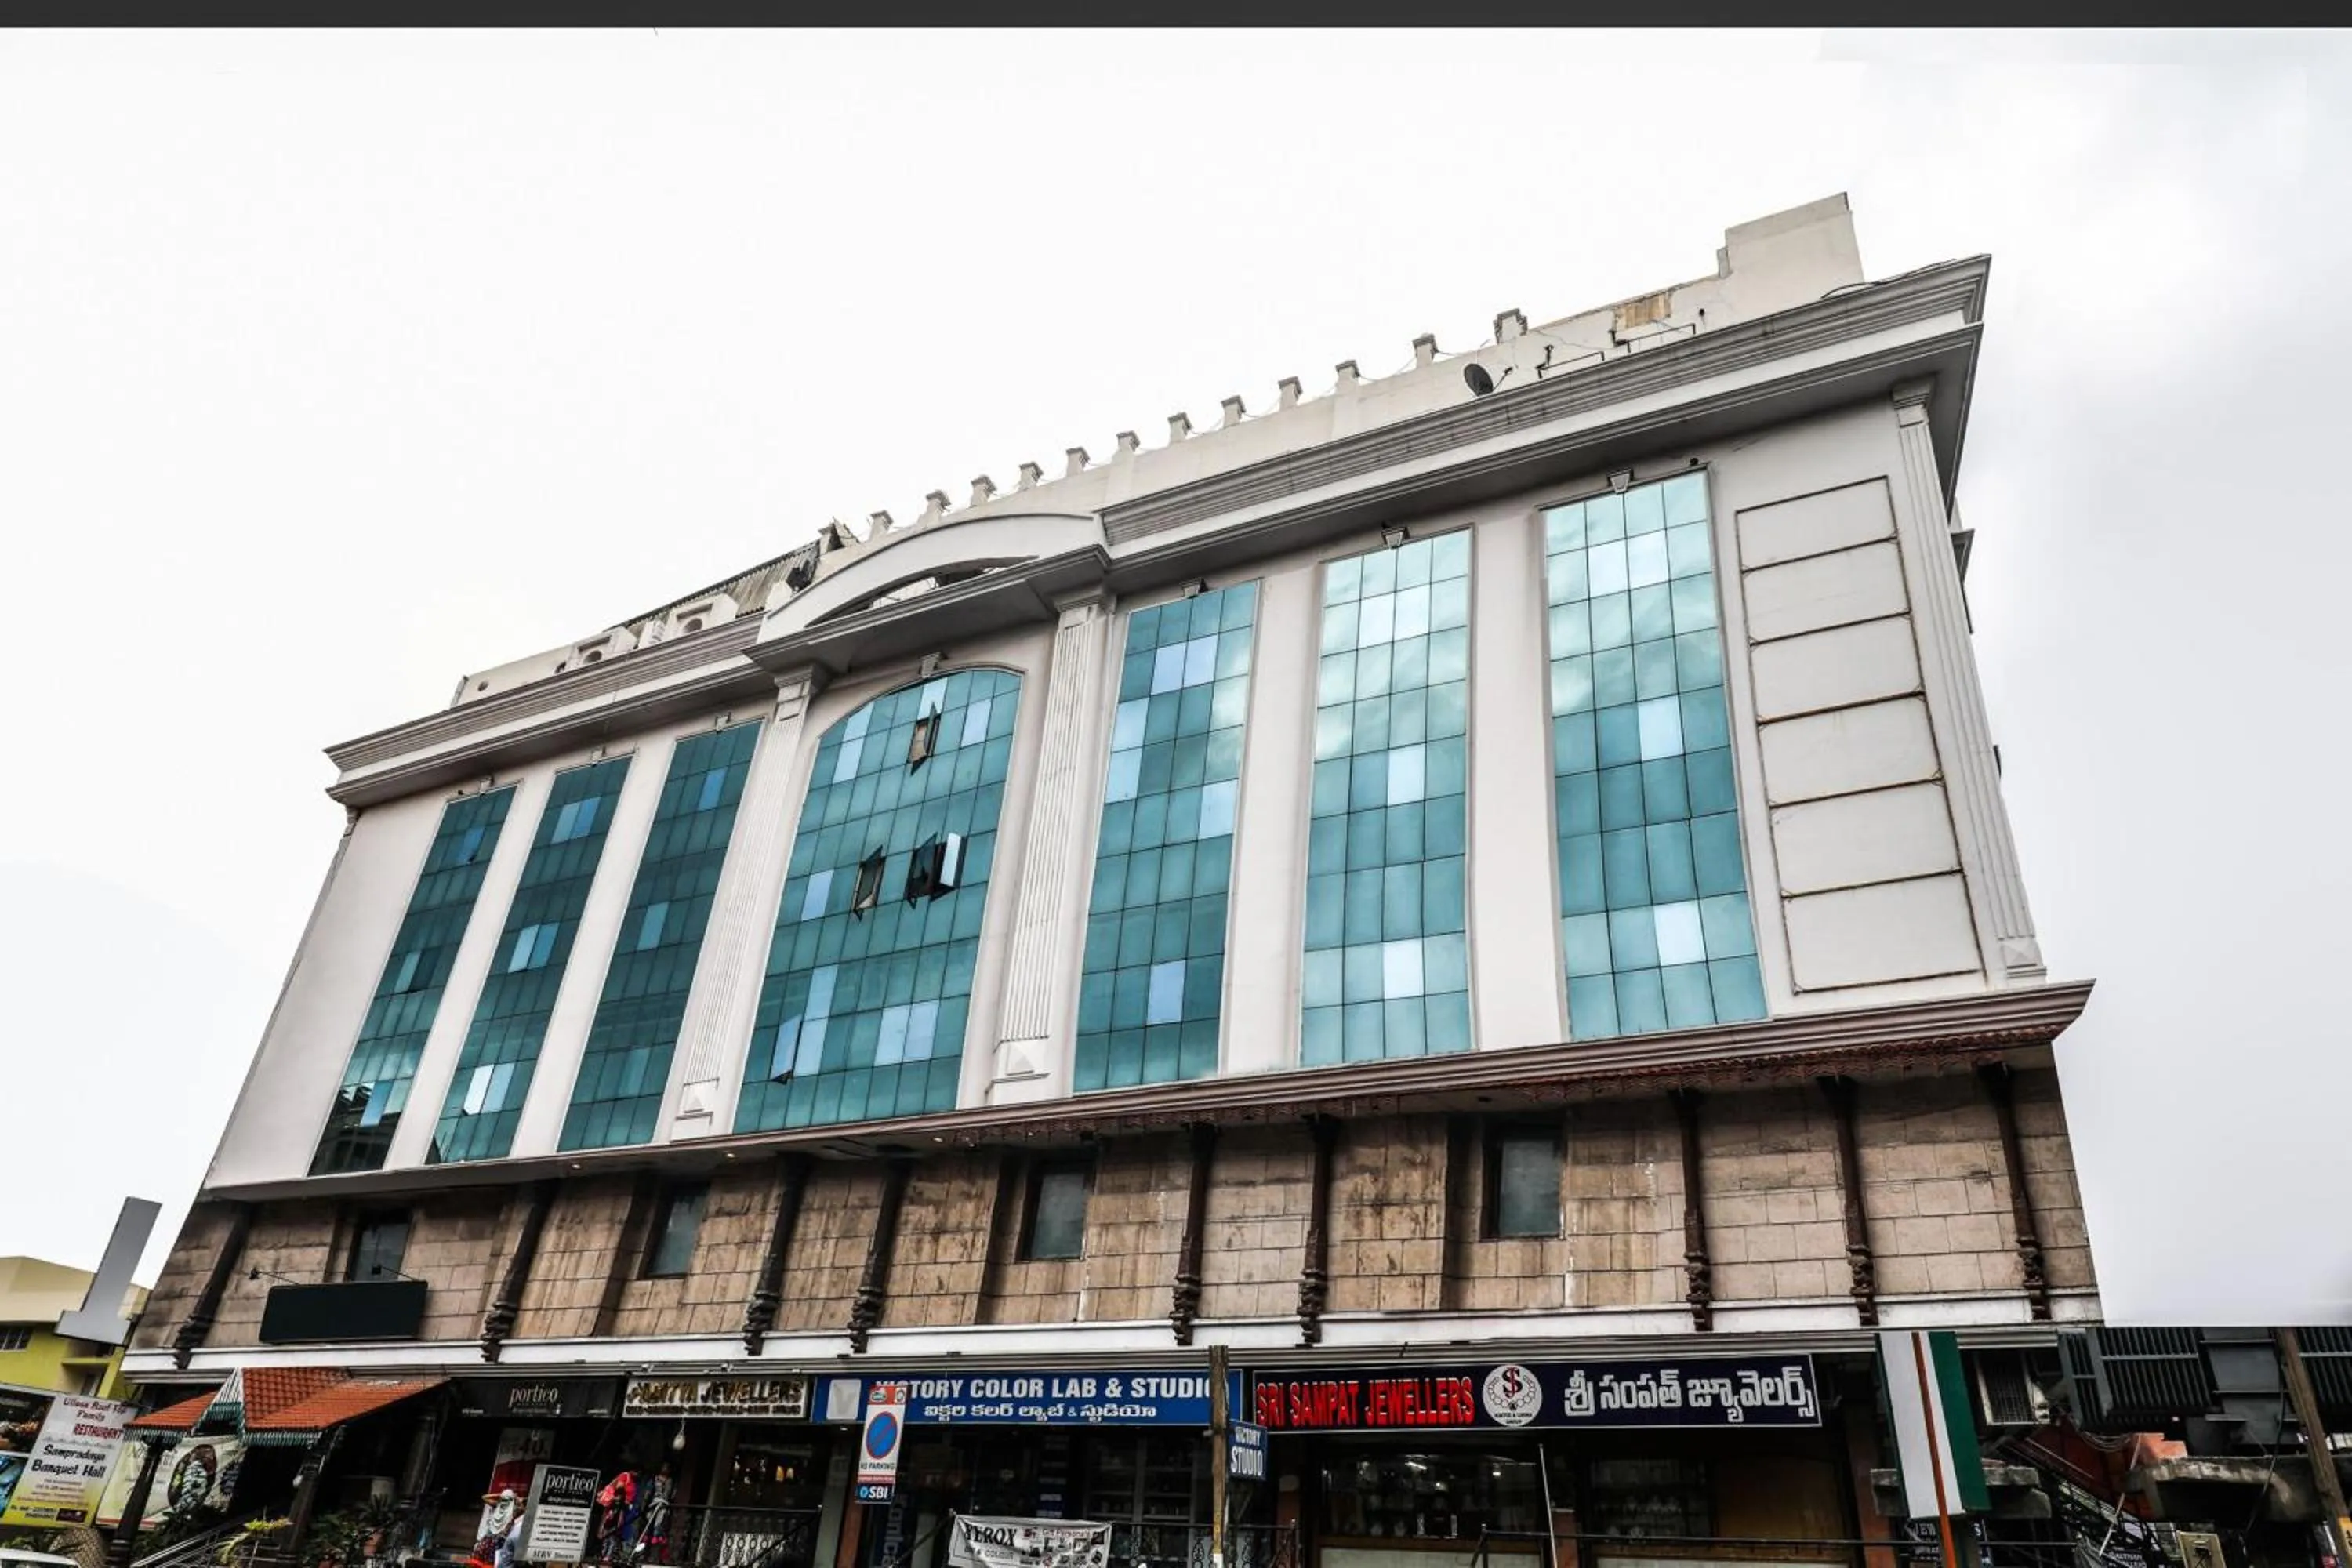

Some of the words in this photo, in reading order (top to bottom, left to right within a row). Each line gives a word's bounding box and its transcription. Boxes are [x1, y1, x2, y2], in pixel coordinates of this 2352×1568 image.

[508, 1383, 559, 1409] portico
[700, 1381, 803, 1403] JEWELLERS
[876, 1379, 964, 1399] TORY
[970, 1378, 1044, 1399] COLOR
[1051, 1378, 1098, 1398] LAB
[1105, 1377, 1123, 1398] &
[1564, 1370, 1595, 1417] శ్రీ
[1599, 1369, 1682, 1409] సంపత్
[971, 1403, 1014, 1417] కలర్
[1067, 1407, 1077, 1417] &
[1257, 1381, 1286, 1427] SRI
[1290, 1381, 1359, 1426] SAMPAT
[1364, 1377, 1475, 1426] JEWELLERS
[77, 1410, 106, 1422] Family
[44, 1443, 106, 1463] Sampradaya
[1230, 1445, 1263, 1476] STUDIO
[31, 1459, 78, 1475] Banquet
[82, 1464, 107, 1479] Hall
[544, 1471, 596, 1494] portico
[868, 1486, 889, 1500] SBI
[881, 1494, 903, 1568] onica
